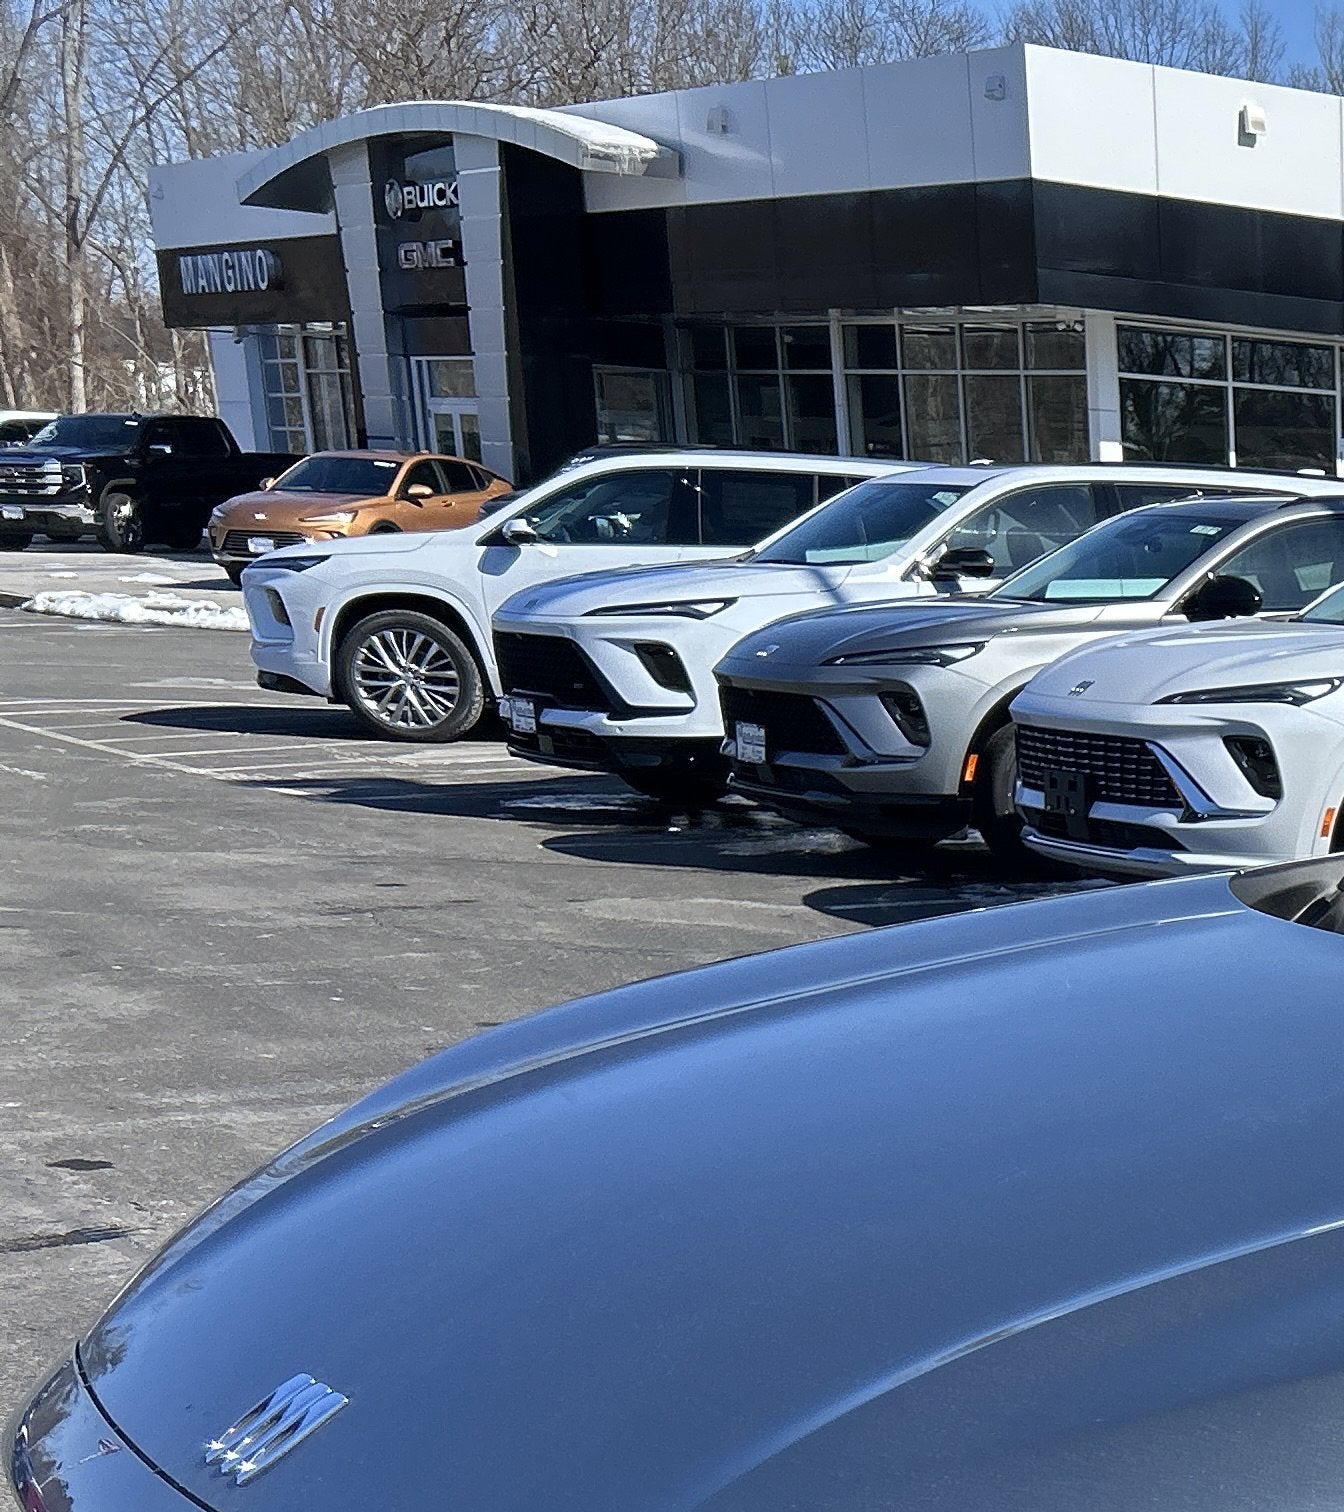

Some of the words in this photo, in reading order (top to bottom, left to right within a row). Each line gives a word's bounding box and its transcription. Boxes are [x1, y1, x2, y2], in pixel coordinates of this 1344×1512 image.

[403, 181, 459, 209] BUICK
[398, 239, 456, 269] GMC
[179, 249, 270, 294] MANGINO
